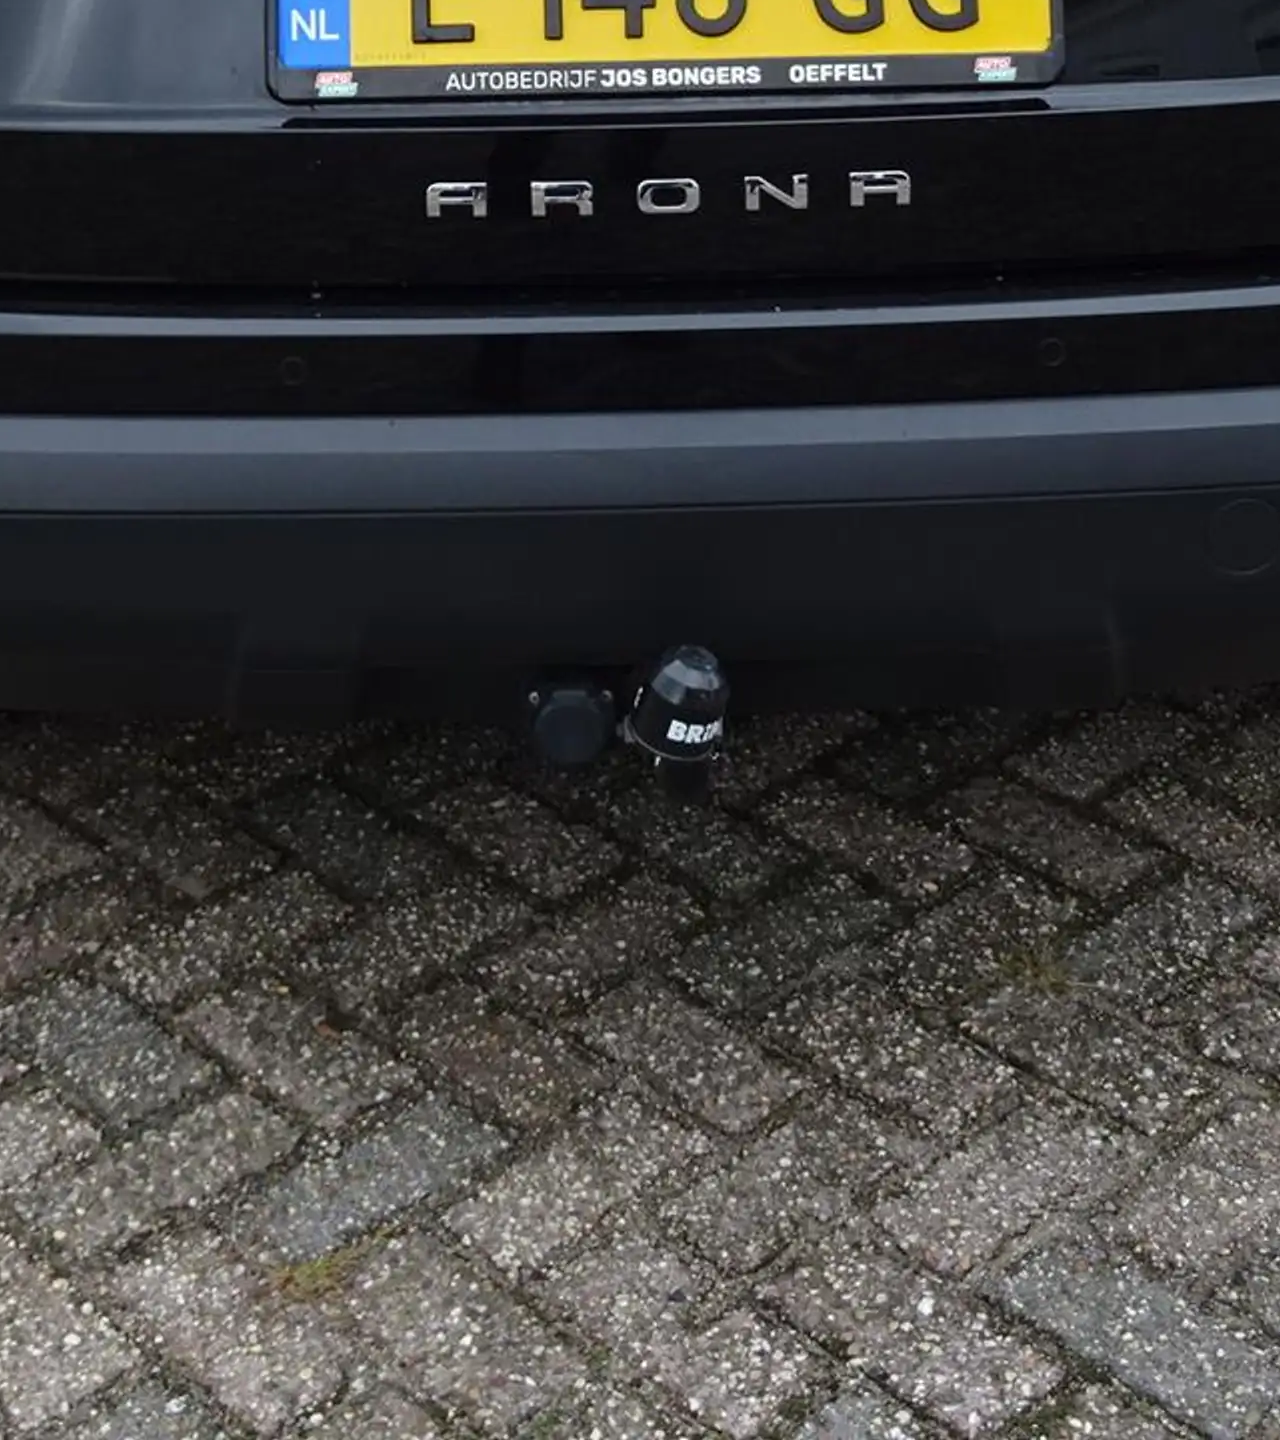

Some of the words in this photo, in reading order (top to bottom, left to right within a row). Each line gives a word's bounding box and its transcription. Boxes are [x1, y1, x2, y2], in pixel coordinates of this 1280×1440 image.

[290, 9, 340, 41] NL
[445, 69, 597, 91] AUTOBEDRIJF
[599, 68, 648, 88] JOS
[651, 65, 762, 87] BONGERS
[789, 62, 888, 84] OEFFELT
[426, 169, 912, 218] ARONA
